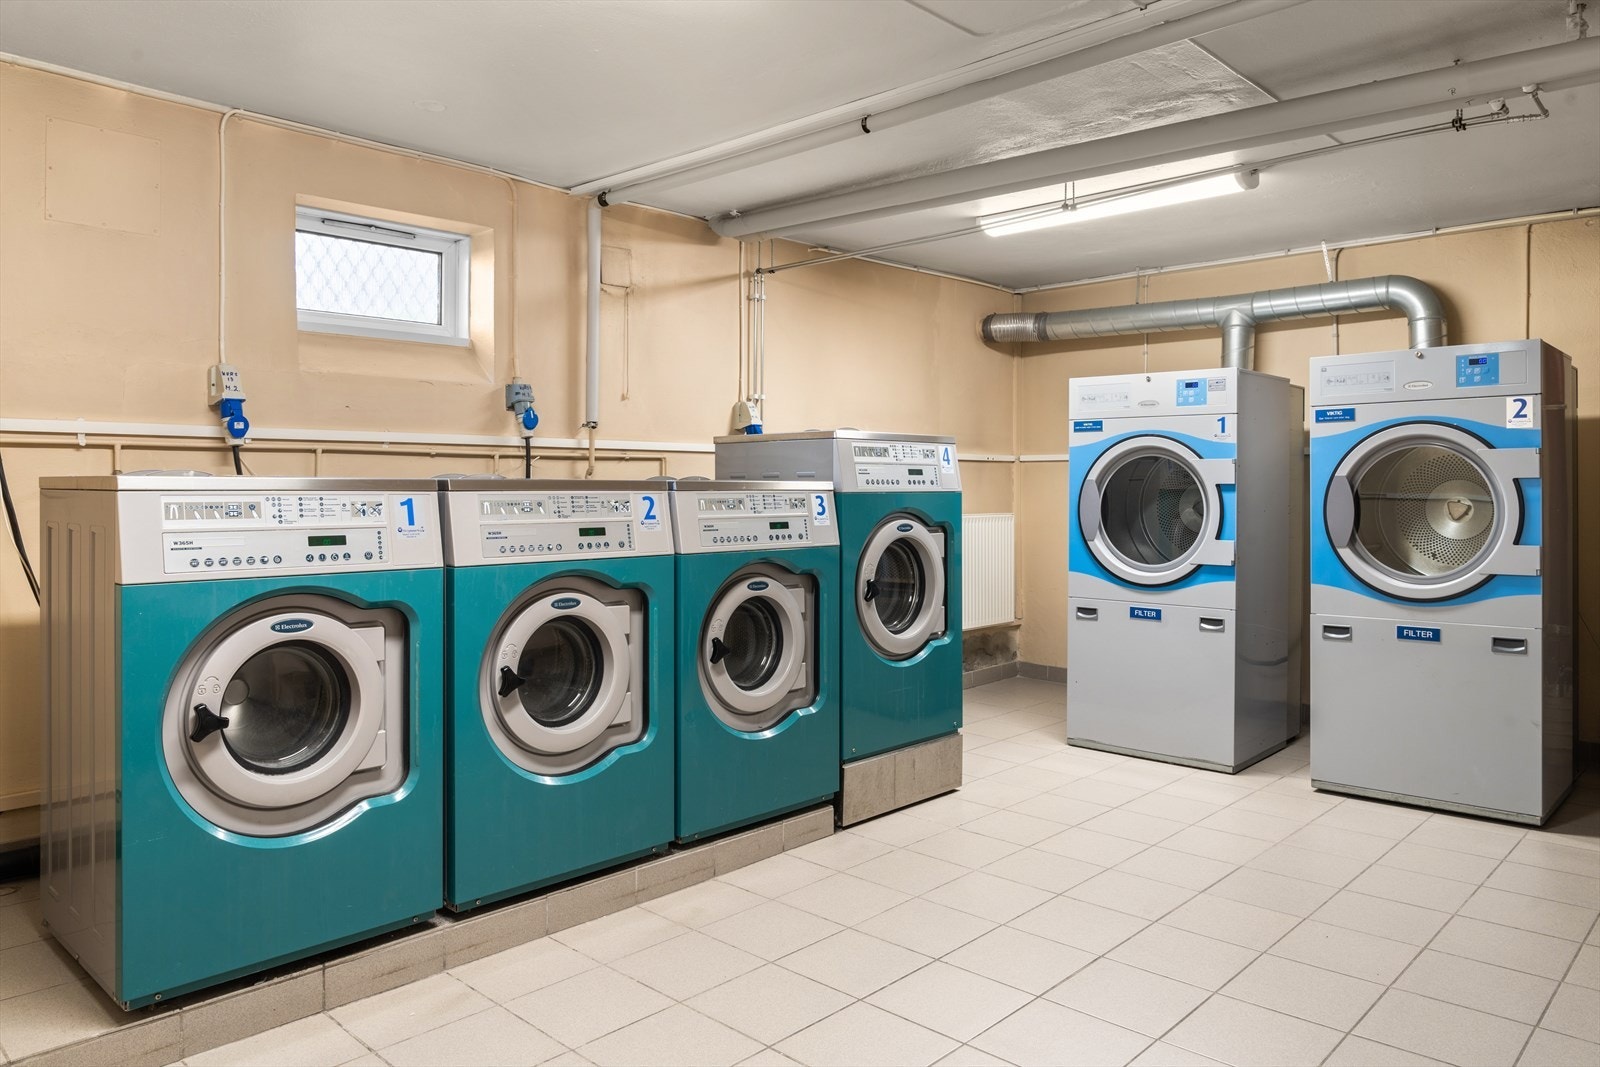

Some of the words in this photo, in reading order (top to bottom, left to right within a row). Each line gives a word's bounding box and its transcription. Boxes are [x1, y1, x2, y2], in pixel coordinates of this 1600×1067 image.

[1513, 398, 1528, 419] 2
[1217, 416, 1226, 434] 1
[943, 447, 951, 465] 4
[400, 498, 415, 526] 1
[642, 496, 657, 520] 2
[815, 495, 826, 516] 3
[1135, 609, 1156, 618] FILTER
[281, 622, 307, 630] Electrolux
[1404, 629, 1433, 638] FILTER
